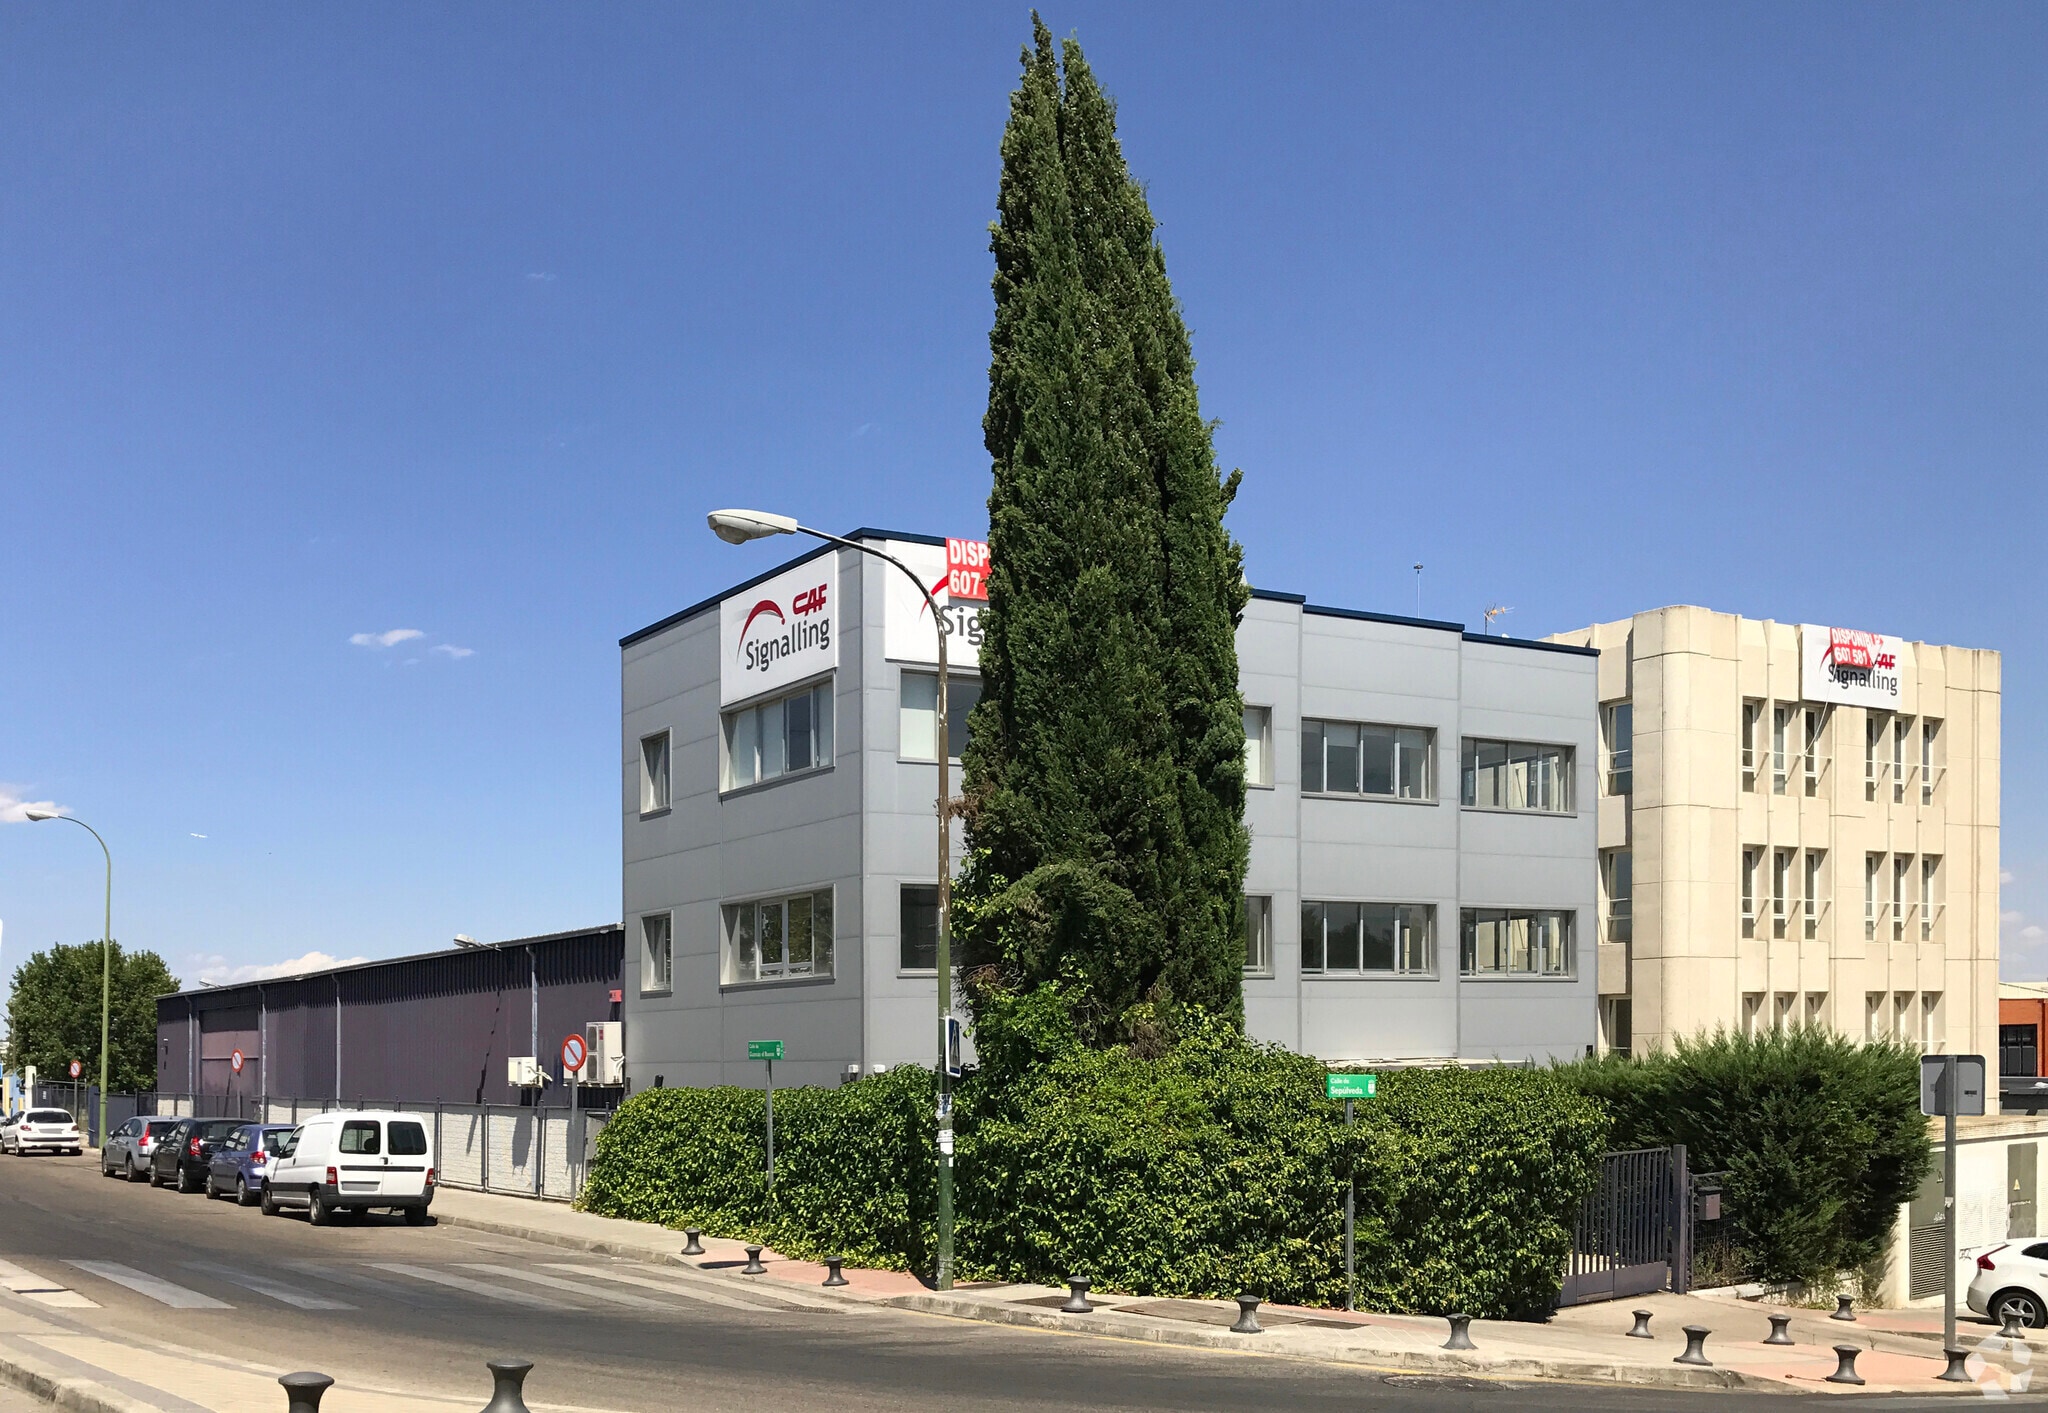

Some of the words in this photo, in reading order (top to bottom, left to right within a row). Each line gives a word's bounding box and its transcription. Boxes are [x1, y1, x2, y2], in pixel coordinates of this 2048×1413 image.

[949, 540, 991, 567] DISP
[950, 569, 980, 595] 607
[793, 583, 827, 616] CAF
[746, 617, 830, 672] Signalling
[1834, 647, 1851, 662] 607
[1828, 663, 1898, 696] Signalling
